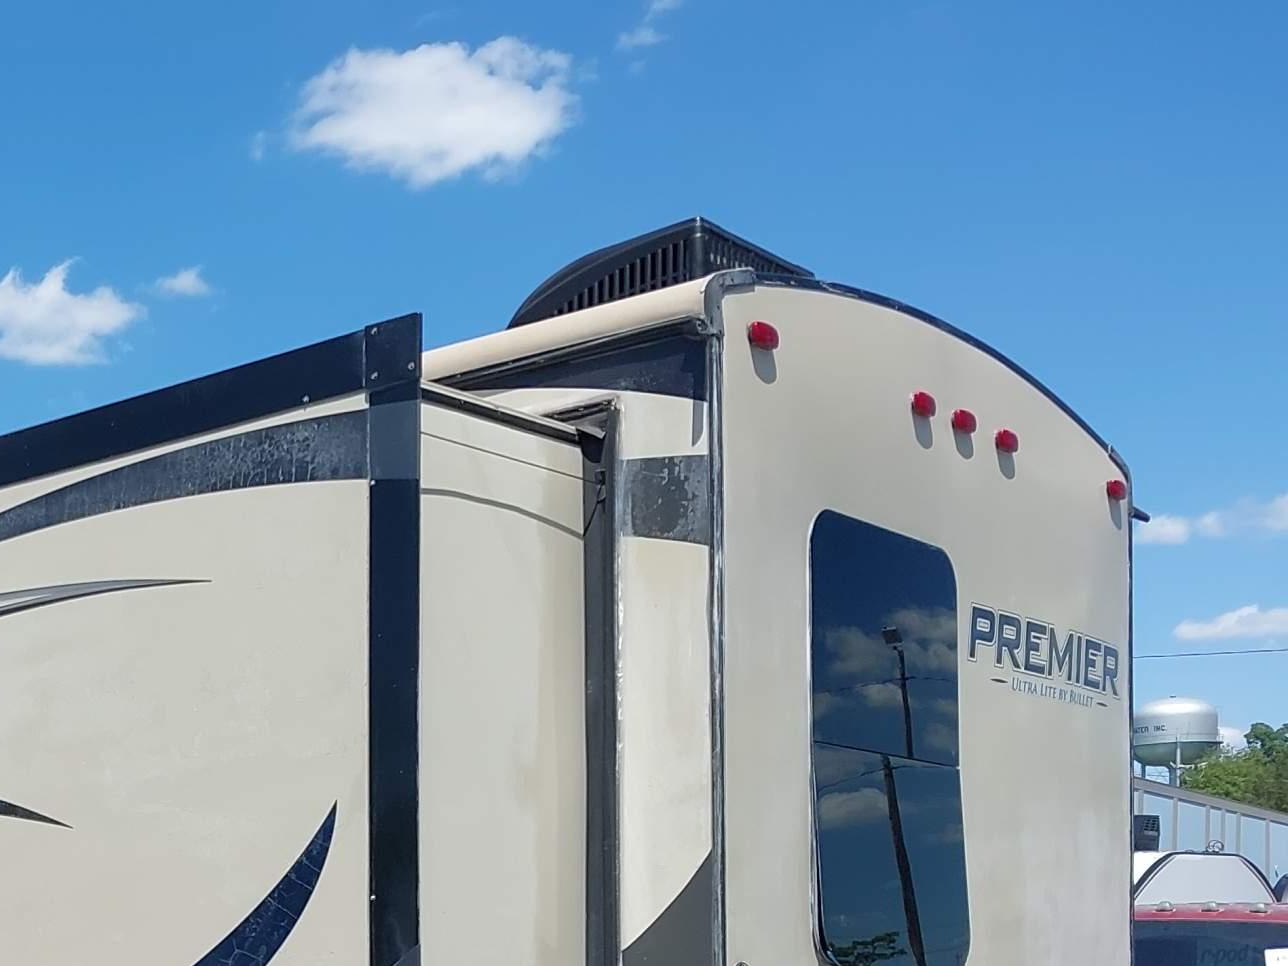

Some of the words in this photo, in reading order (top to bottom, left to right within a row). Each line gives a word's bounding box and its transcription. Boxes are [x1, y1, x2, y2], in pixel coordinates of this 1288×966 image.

[968, 602, 1121, 700] PREMIER
[1012, 677, 1037, 695] ULTRA
[1040, 683, 1057, 699] LITE
[1069, 689, 1094, 707] BULLET
